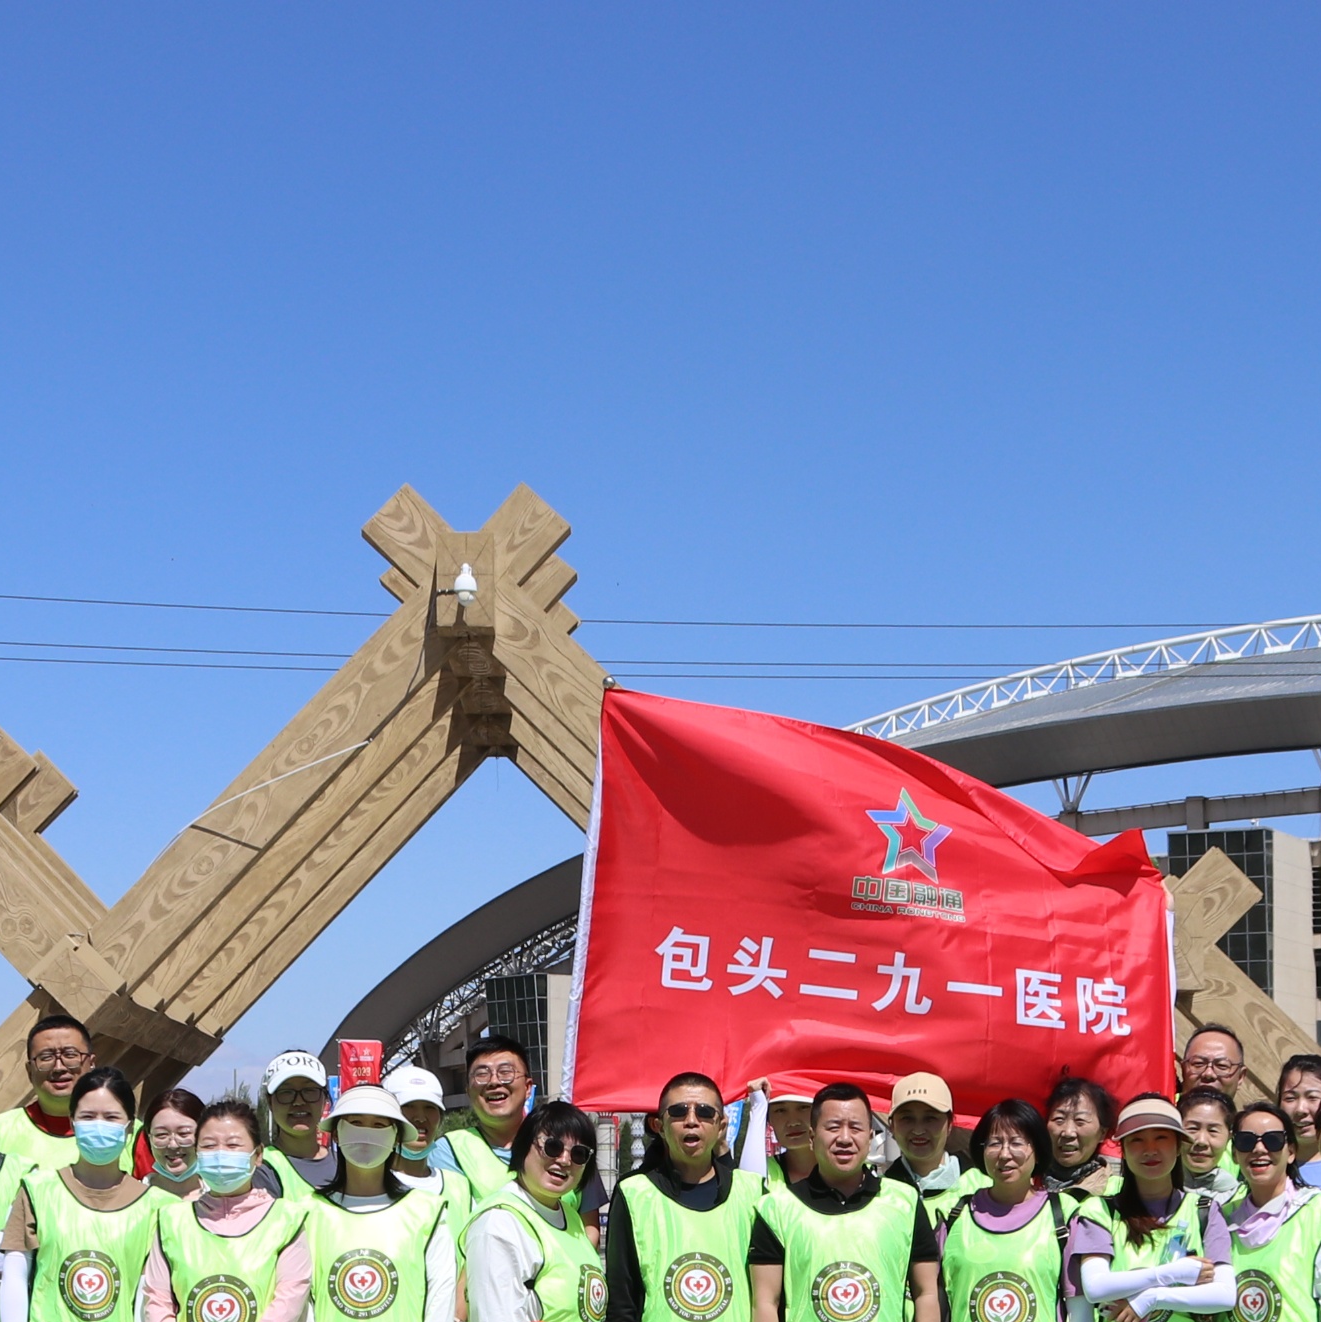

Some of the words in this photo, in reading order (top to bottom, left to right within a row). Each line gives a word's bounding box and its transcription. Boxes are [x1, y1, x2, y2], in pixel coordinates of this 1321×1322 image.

[851, 876, 964, 914] 中国融通
[851, 901, 893, 914] CHINA
[655, 926, 1132, 1036] 包头二九一医院
[266, 1056, 323, 1078] SPORT
[332, 1295, 343, 1309] BAO
[344, 1306, 356, 1317] TOU
[371, 1294, 394, 1316] HOSPITAL
[669, 1298, 678, 1310] BAO
[679, 1308, 690, 1318] TOU
[706, 1300, 728, 1319] HOSPITAL
[818, 1310, 827, 1322] BAO
